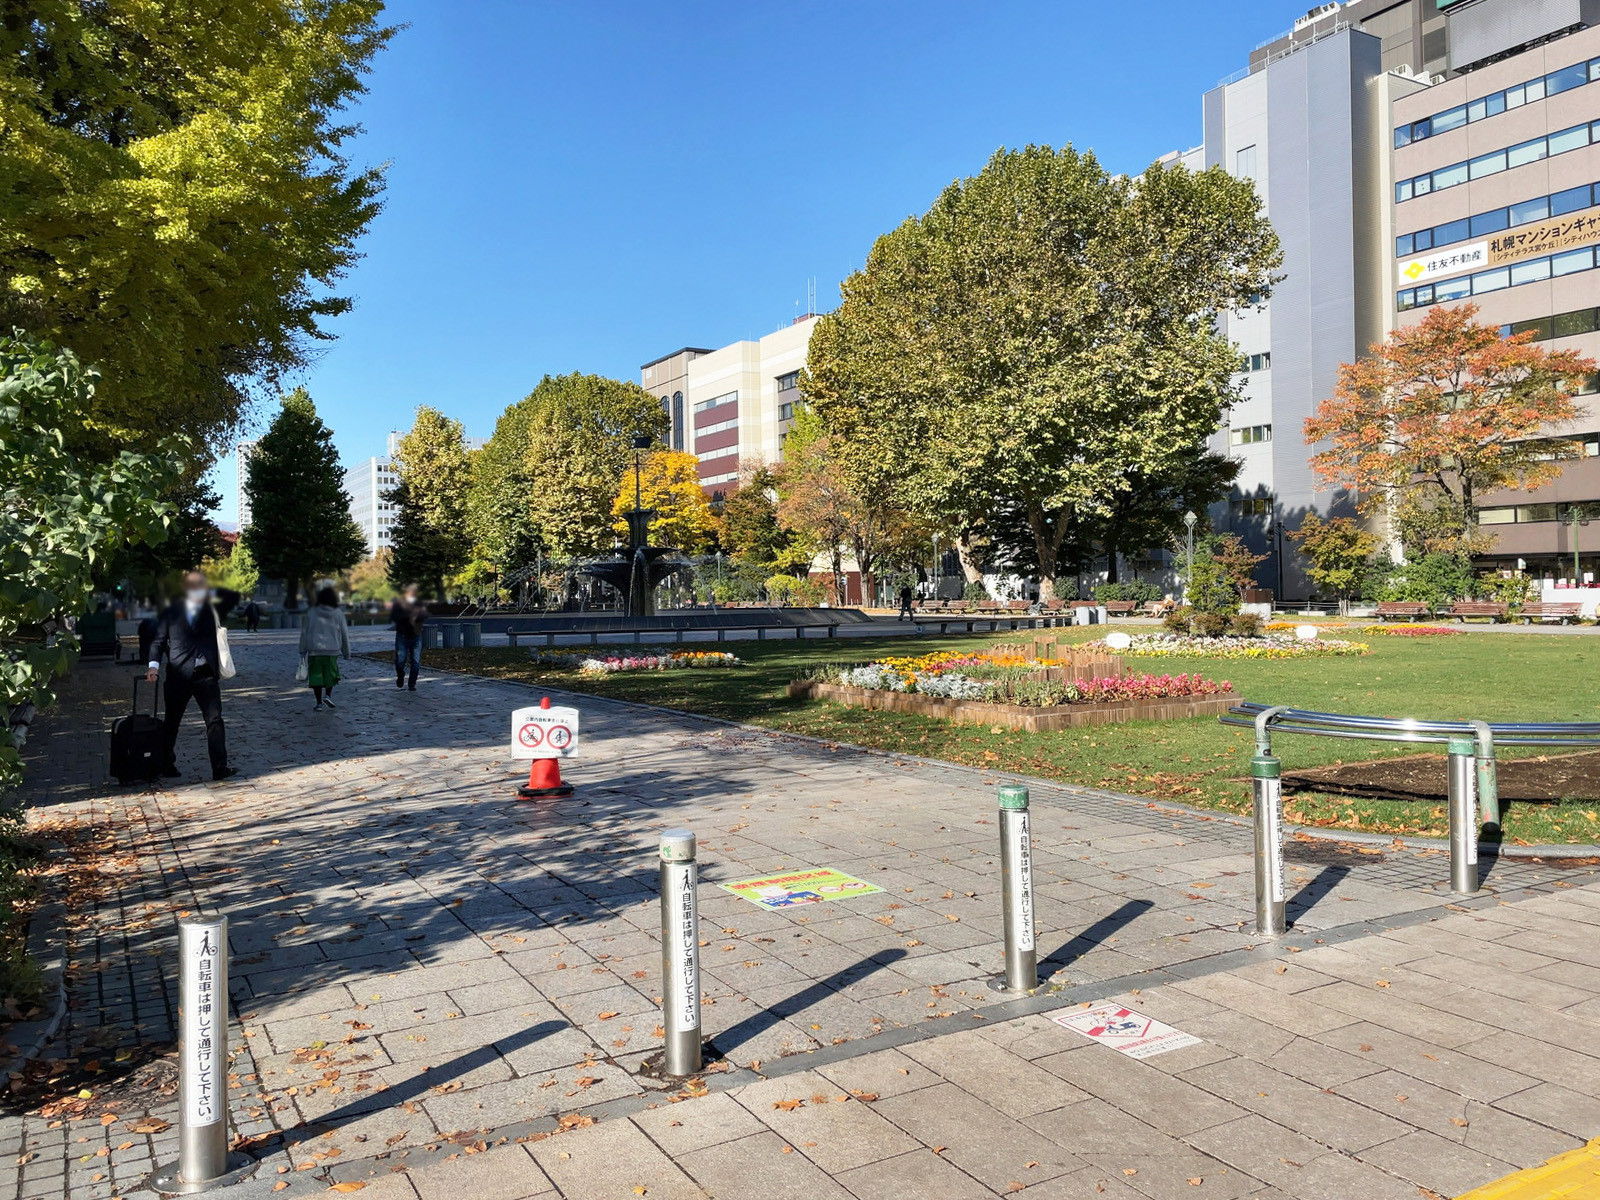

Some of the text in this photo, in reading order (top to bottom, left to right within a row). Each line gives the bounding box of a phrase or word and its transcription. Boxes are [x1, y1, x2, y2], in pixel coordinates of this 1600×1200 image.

[1491, 214, 1600, 253] 札幌マンションギャ
[1427, 250, 1482, 272] 住友不動産
[198, 958, 212, 1121] 自転車は押して通行して下さい。
